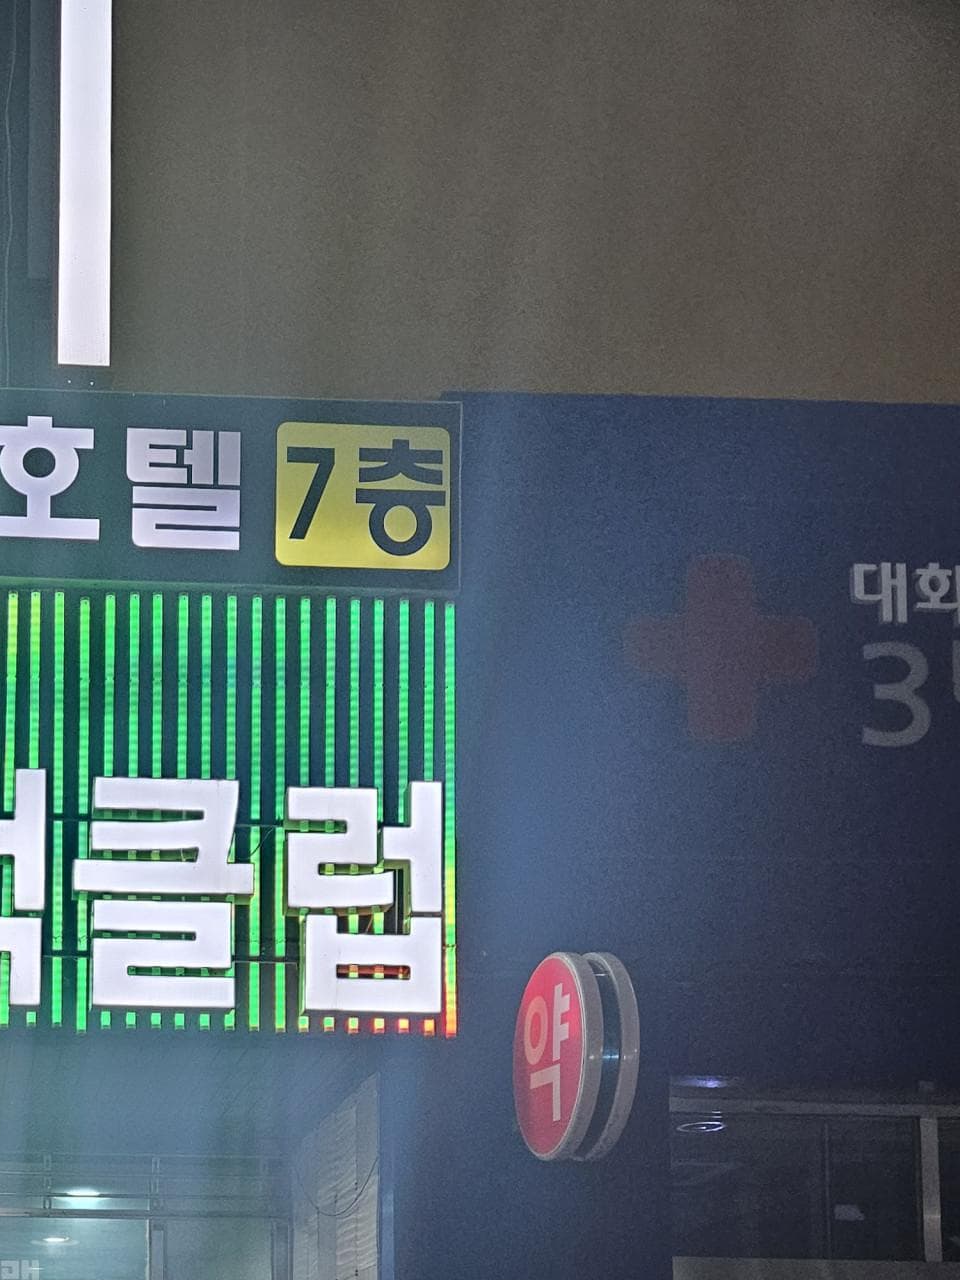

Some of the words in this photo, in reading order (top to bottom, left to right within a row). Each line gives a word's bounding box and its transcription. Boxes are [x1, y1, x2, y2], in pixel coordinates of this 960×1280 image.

[287, 438, 447, 557] 7층
[862, 641, 960, 747] 3
[524, 982, 571, 1122] 약
